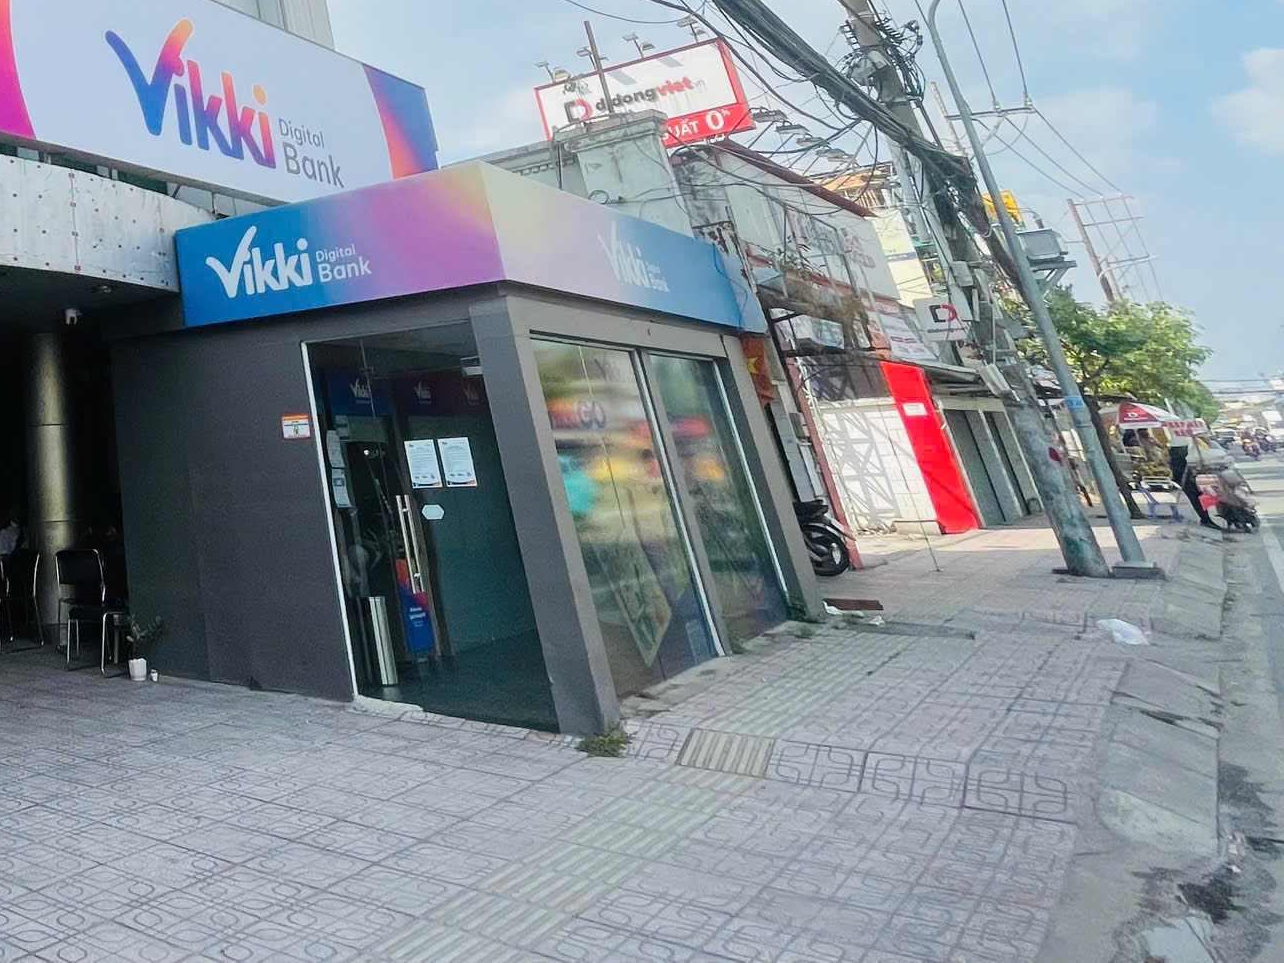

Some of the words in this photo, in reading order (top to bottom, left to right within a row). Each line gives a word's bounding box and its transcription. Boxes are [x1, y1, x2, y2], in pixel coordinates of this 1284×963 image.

[105, 18, 276, 170] Vikki
[278, 117, 325, 149] Digital
[706, 109, 731, 131] 0%
[282, 141, 345, 188] Bank
[205, 225, 314, 299] Vikki
[316, 244, 357, 263] Digital
[317, 256, 373, 283] Bank
